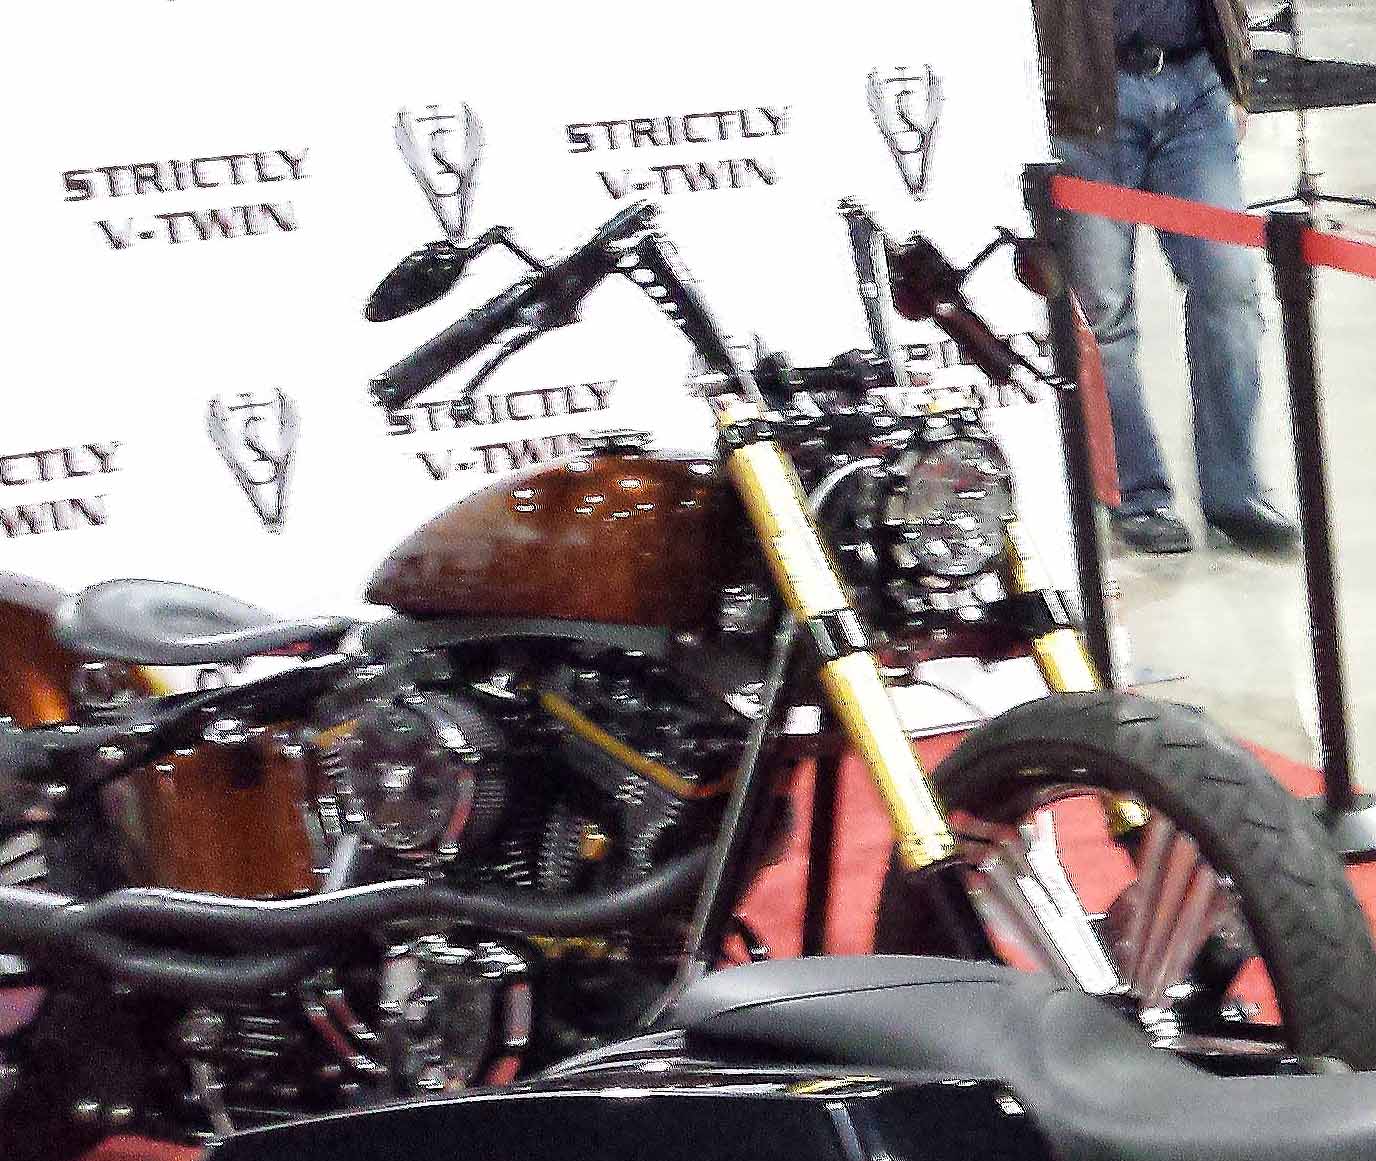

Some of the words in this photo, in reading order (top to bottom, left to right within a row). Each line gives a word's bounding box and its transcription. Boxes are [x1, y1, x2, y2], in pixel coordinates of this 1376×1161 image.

[565, 106, 791, 153] STRICTLY
[62, 147, 309, 201] STRICTLY
[597, 158, 776, 200] V-TWIN
[95, 201, 298, 250] V-TWIN
